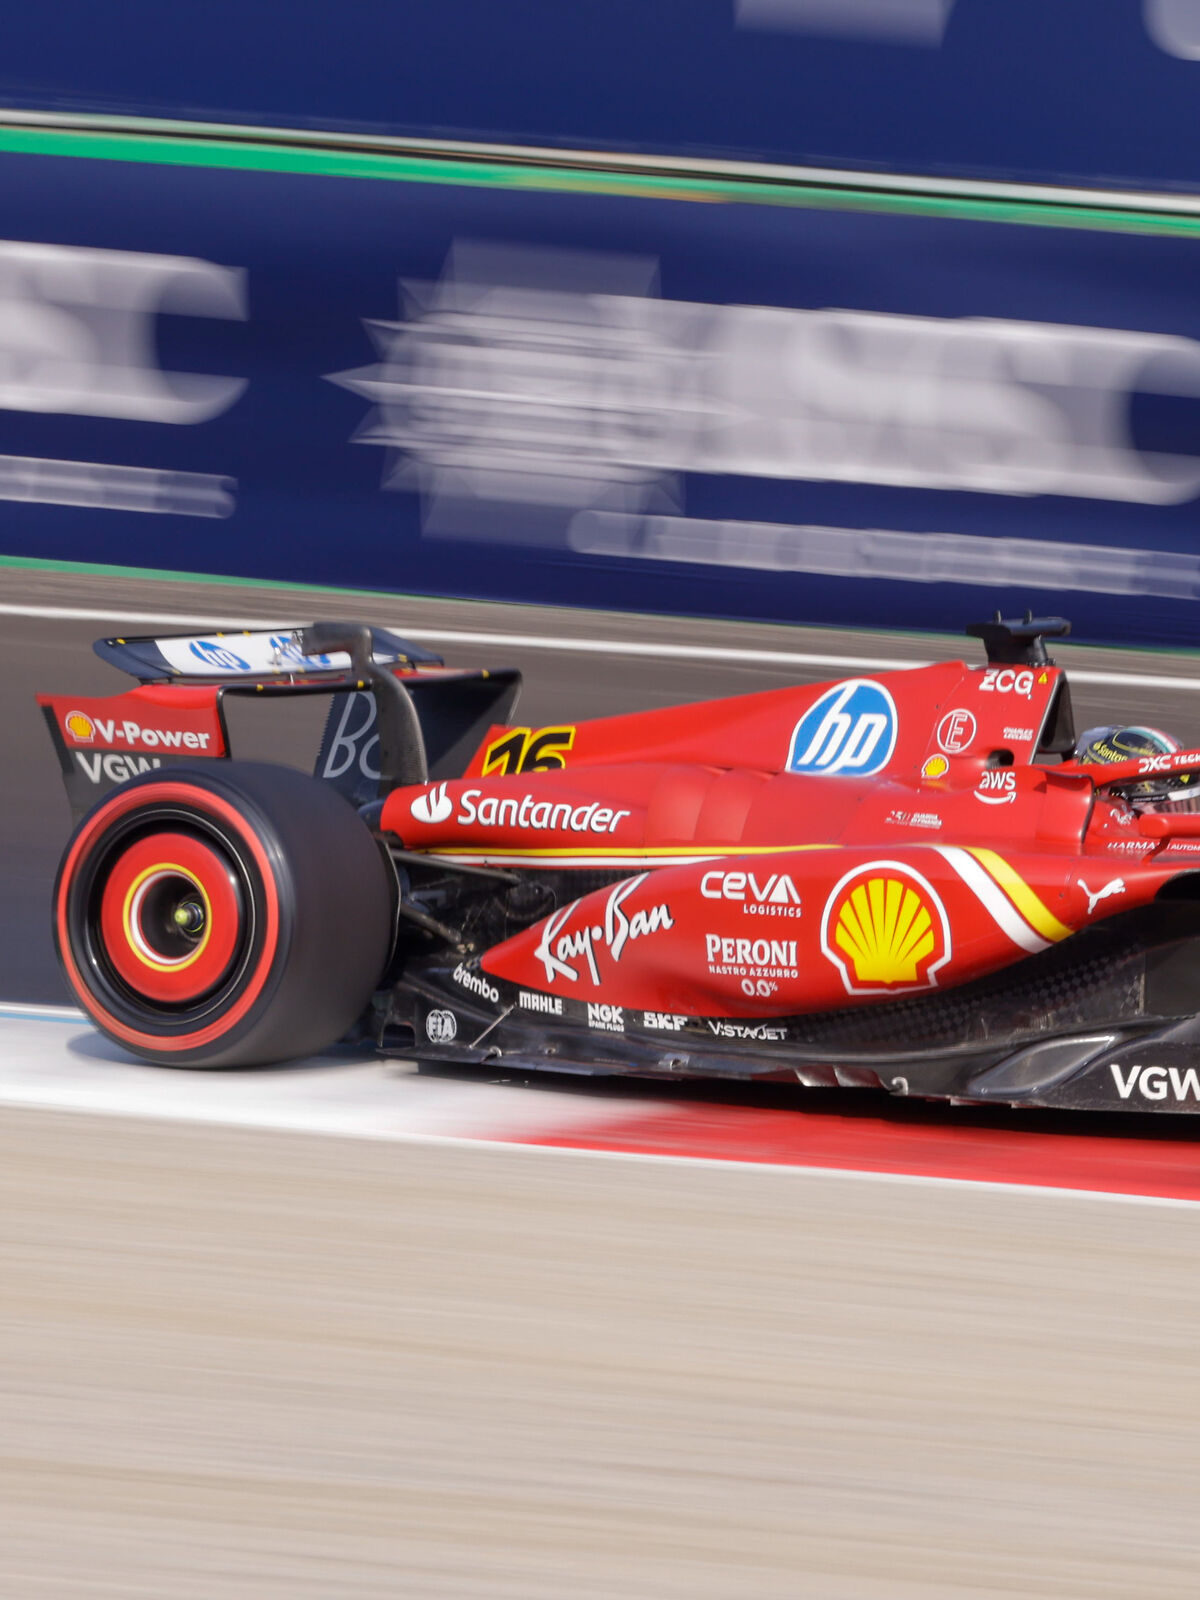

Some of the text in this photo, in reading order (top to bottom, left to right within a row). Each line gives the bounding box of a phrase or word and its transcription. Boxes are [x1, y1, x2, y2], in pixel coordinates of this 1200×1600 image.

[194, 641, 247, 670] hp
[95, 718, 210, 749] V-Power
[797, 684, 888, 774] hp
[481, 726, 576, 777] 16
[76, 752, 161, 784] VGW
[979, 771, 1016, 790] aws
[457, 789, 630, 833] Santander
[1107, 841, 1161, 851] HARMA
[743, 904, 802, 918] LOGISTICS
[705, 933, 798, 966] PERONI
[453, 962, 499, 1003] brembo
[708, 964, 799, 978] NASTRO AZZURRO
[519, 991, 563, 1015] MAHLE
[587, 1002, 624, 1025] NGK
[643, 1011, 688, 1031] SKF
